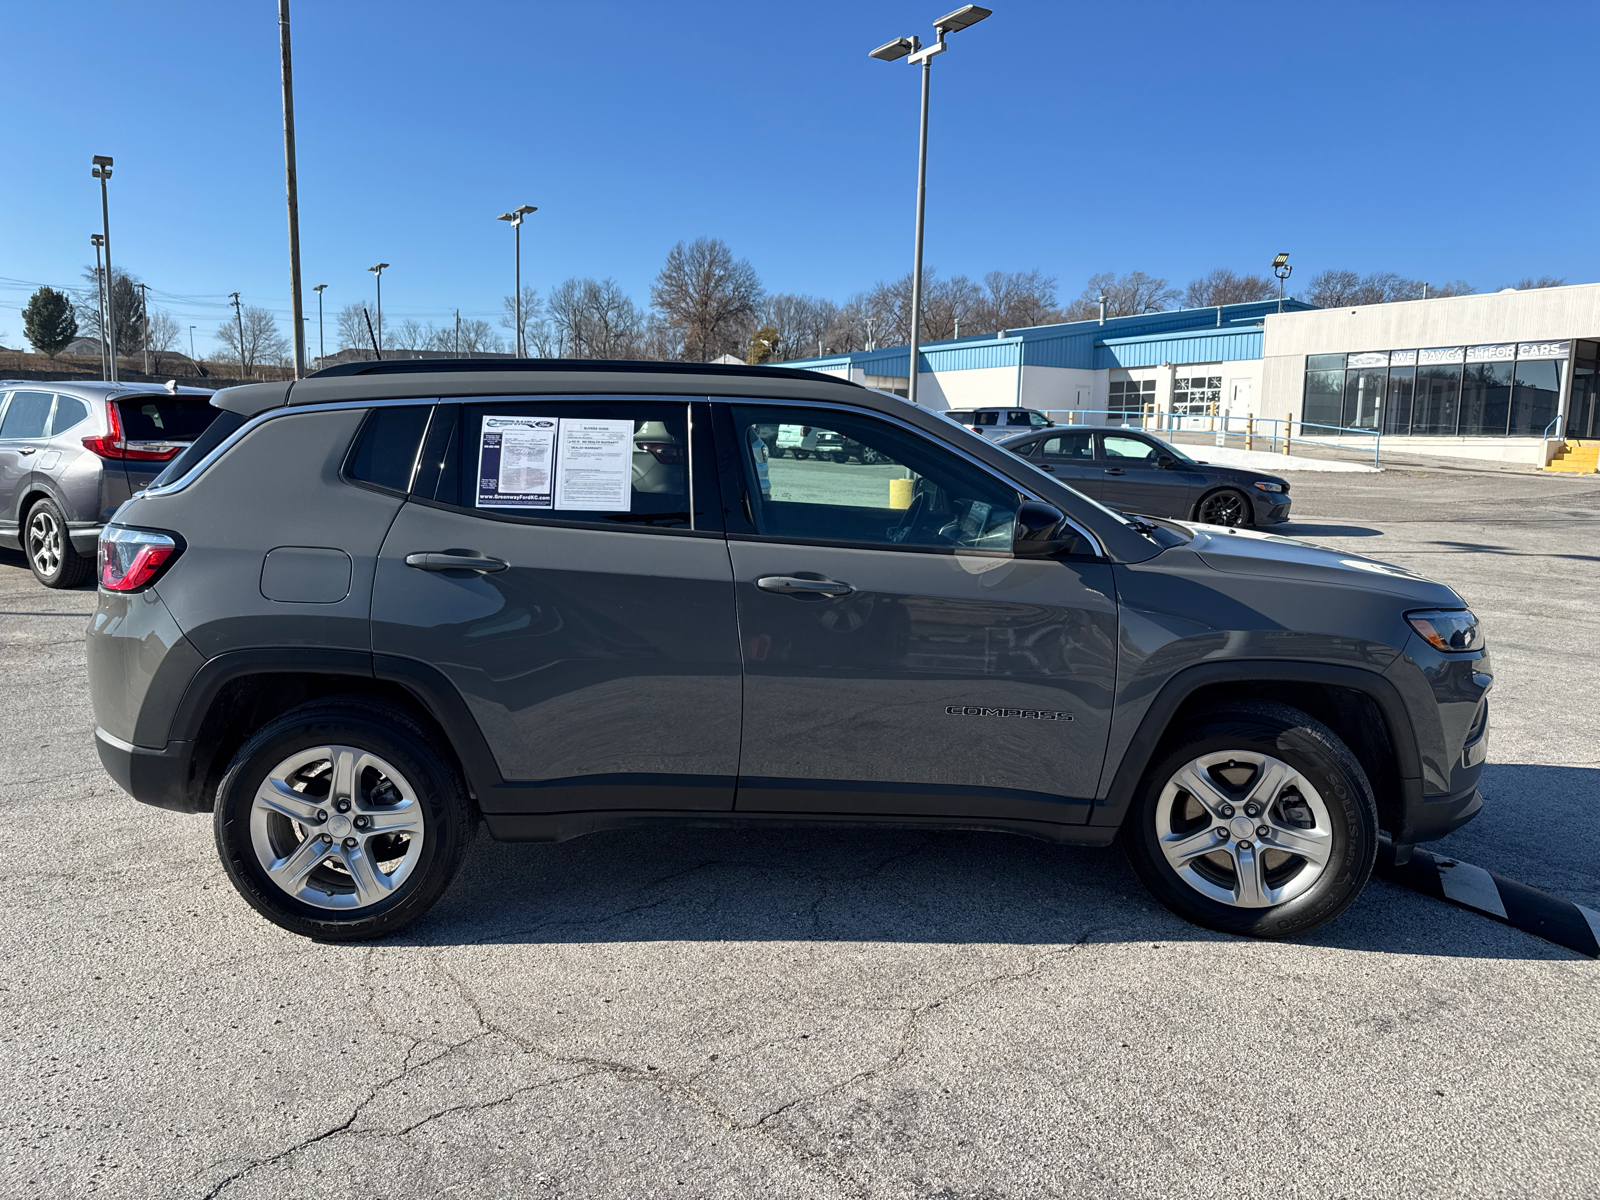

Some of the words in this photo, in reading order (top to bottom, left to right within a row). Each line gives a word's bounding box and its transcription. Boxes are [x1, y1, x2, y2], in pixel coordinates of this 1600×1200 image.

[1395, 352, 1415, 363] WE
[1419, 350, 1445, 362] PAY
[1445, 346, 1486, 360] CASH
[1488, 345, 1515, 357] FOR
[1519, 343, 1561, 357] CARS
[945, 705, 1074, 721] COMPASS
[1325, 773, 1359, 837] SOLUS
